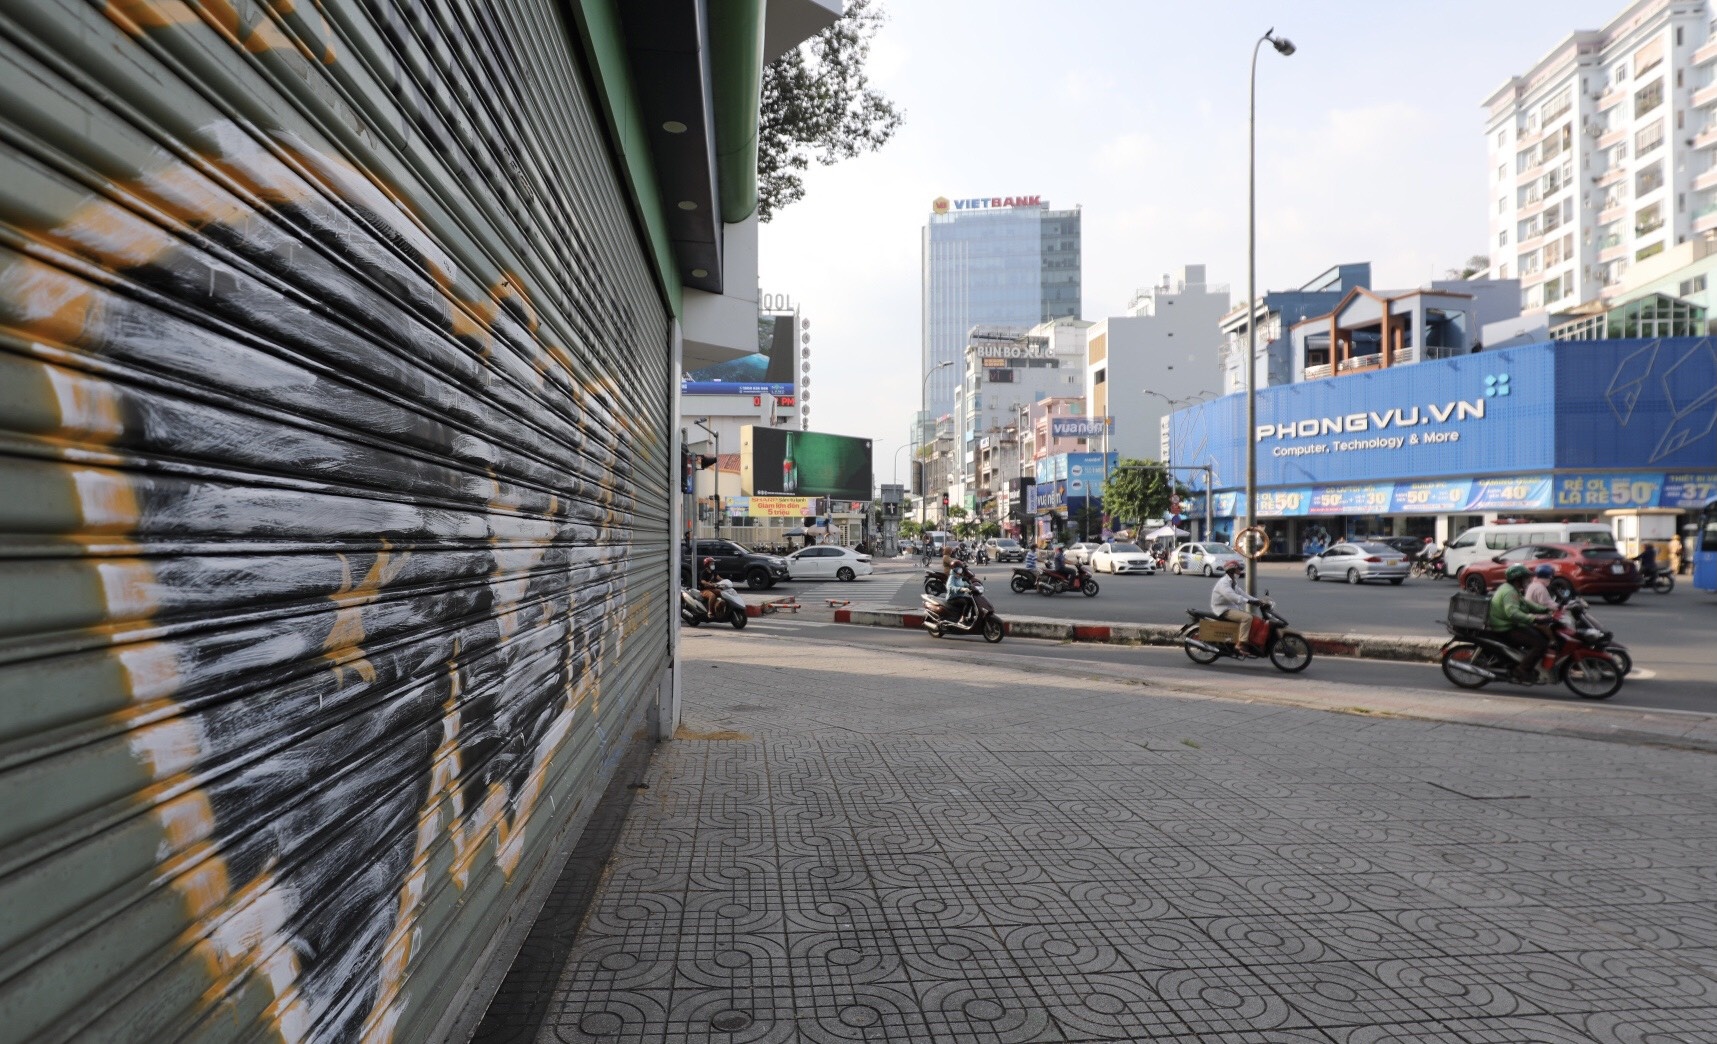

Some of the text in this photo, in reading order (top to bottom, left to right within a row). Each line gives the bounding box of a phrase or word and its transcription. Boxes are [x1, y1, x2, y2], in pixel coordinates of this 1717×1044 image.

[954, 195, 1041, 209] VIETBANK
[977, 343, 1001, 357] BÚN
[781, 397, 795, 406] PM
[1256, 399, 1484, 442] PHONGVU.VN
[1273, 430, 1460, 458] Computer, Technology & More
